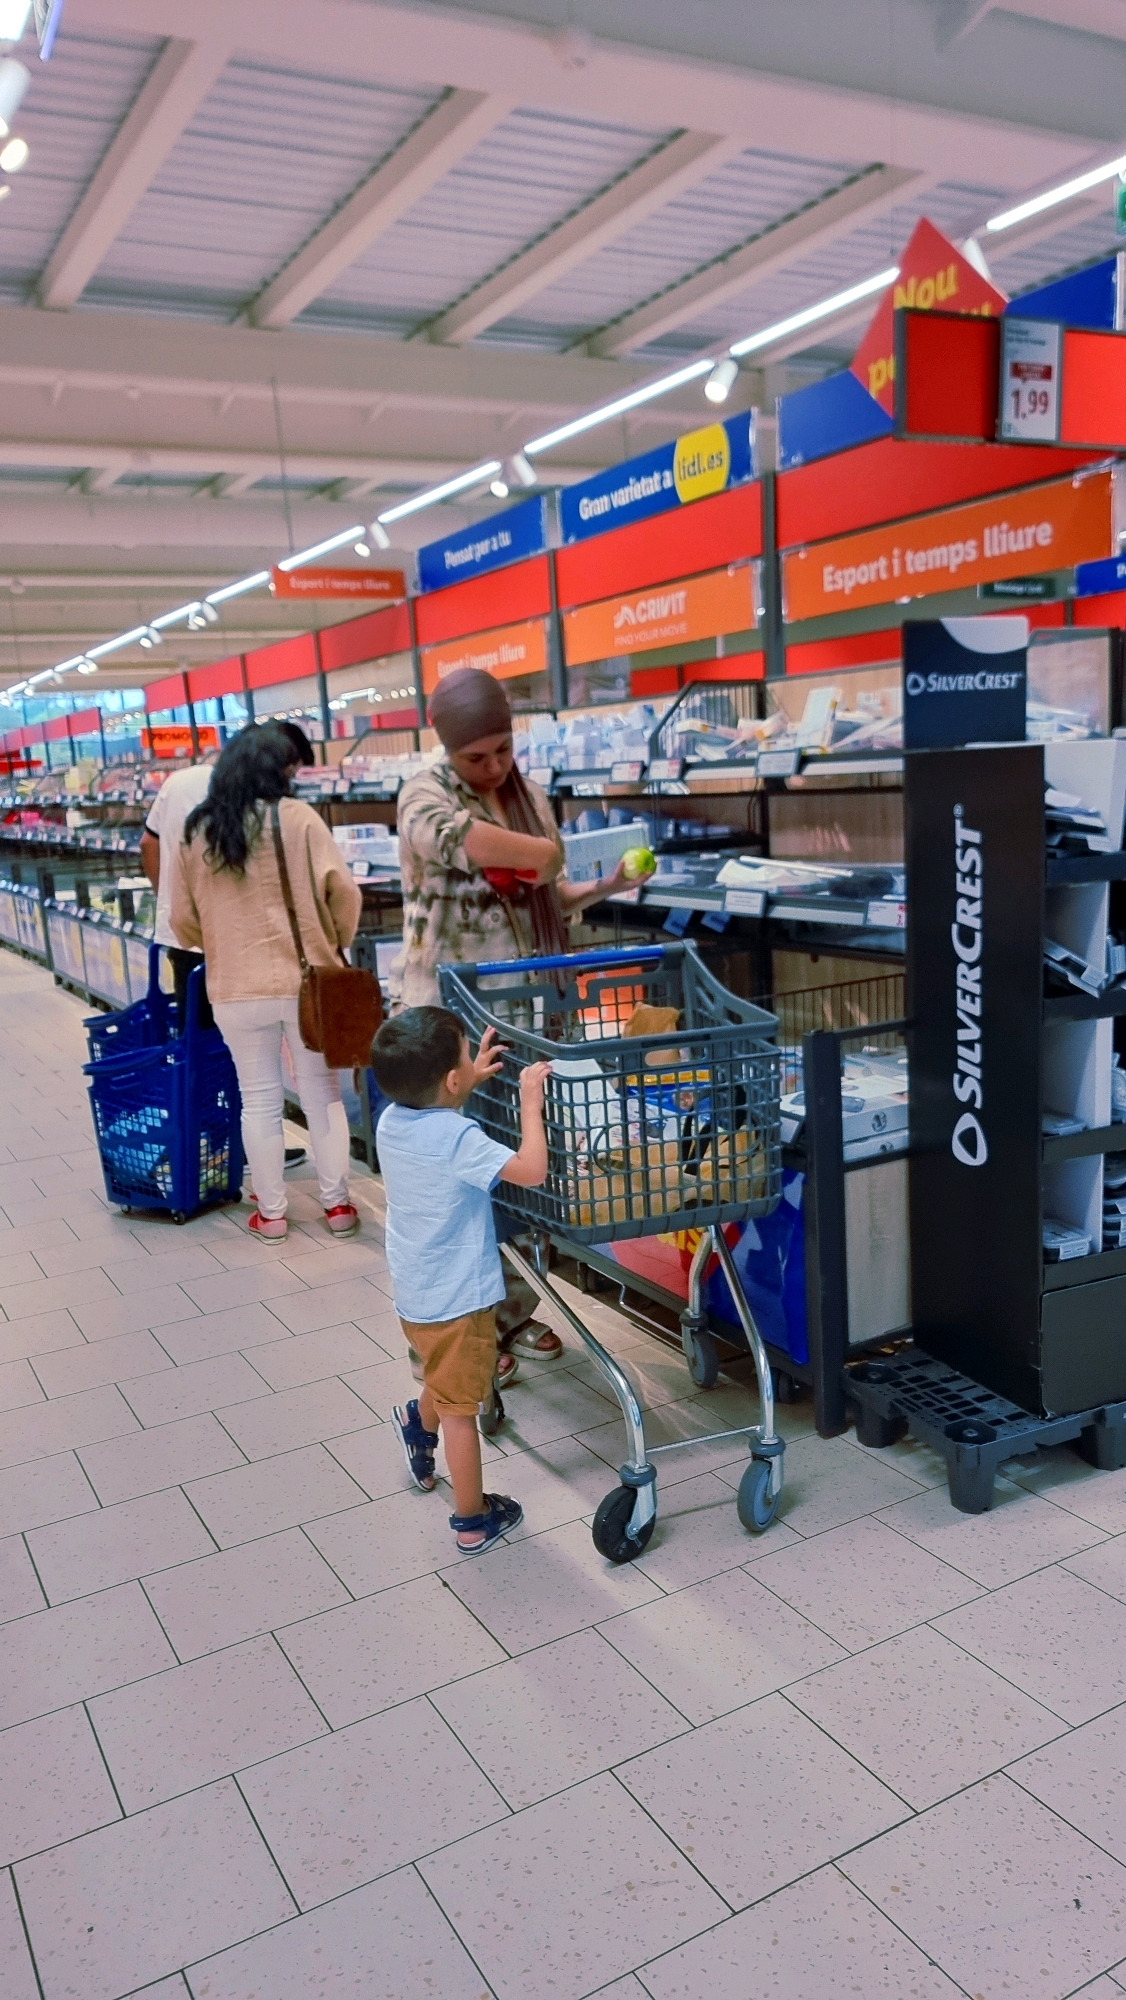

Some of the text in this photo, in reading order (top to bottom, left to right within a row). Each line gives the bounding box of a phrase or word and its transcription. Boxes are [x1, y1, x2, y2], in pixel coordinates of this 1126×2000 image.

[893, 264, 957, 310] Nou
[1010, 388, 1050, 420] 1.99
[578, 450, 724, 521] Gran varietat a lidl.es
[443, 544, 474, 570] Pensat
[474, 538, 491, 563] per
[822, 521, 1053, 595] Esport i temps lliure
[636, 590, 687, 624] CRIVIT
[499, 644, 527, 665] lliure
[926, 671, 1018, 692] SILVERCREST
